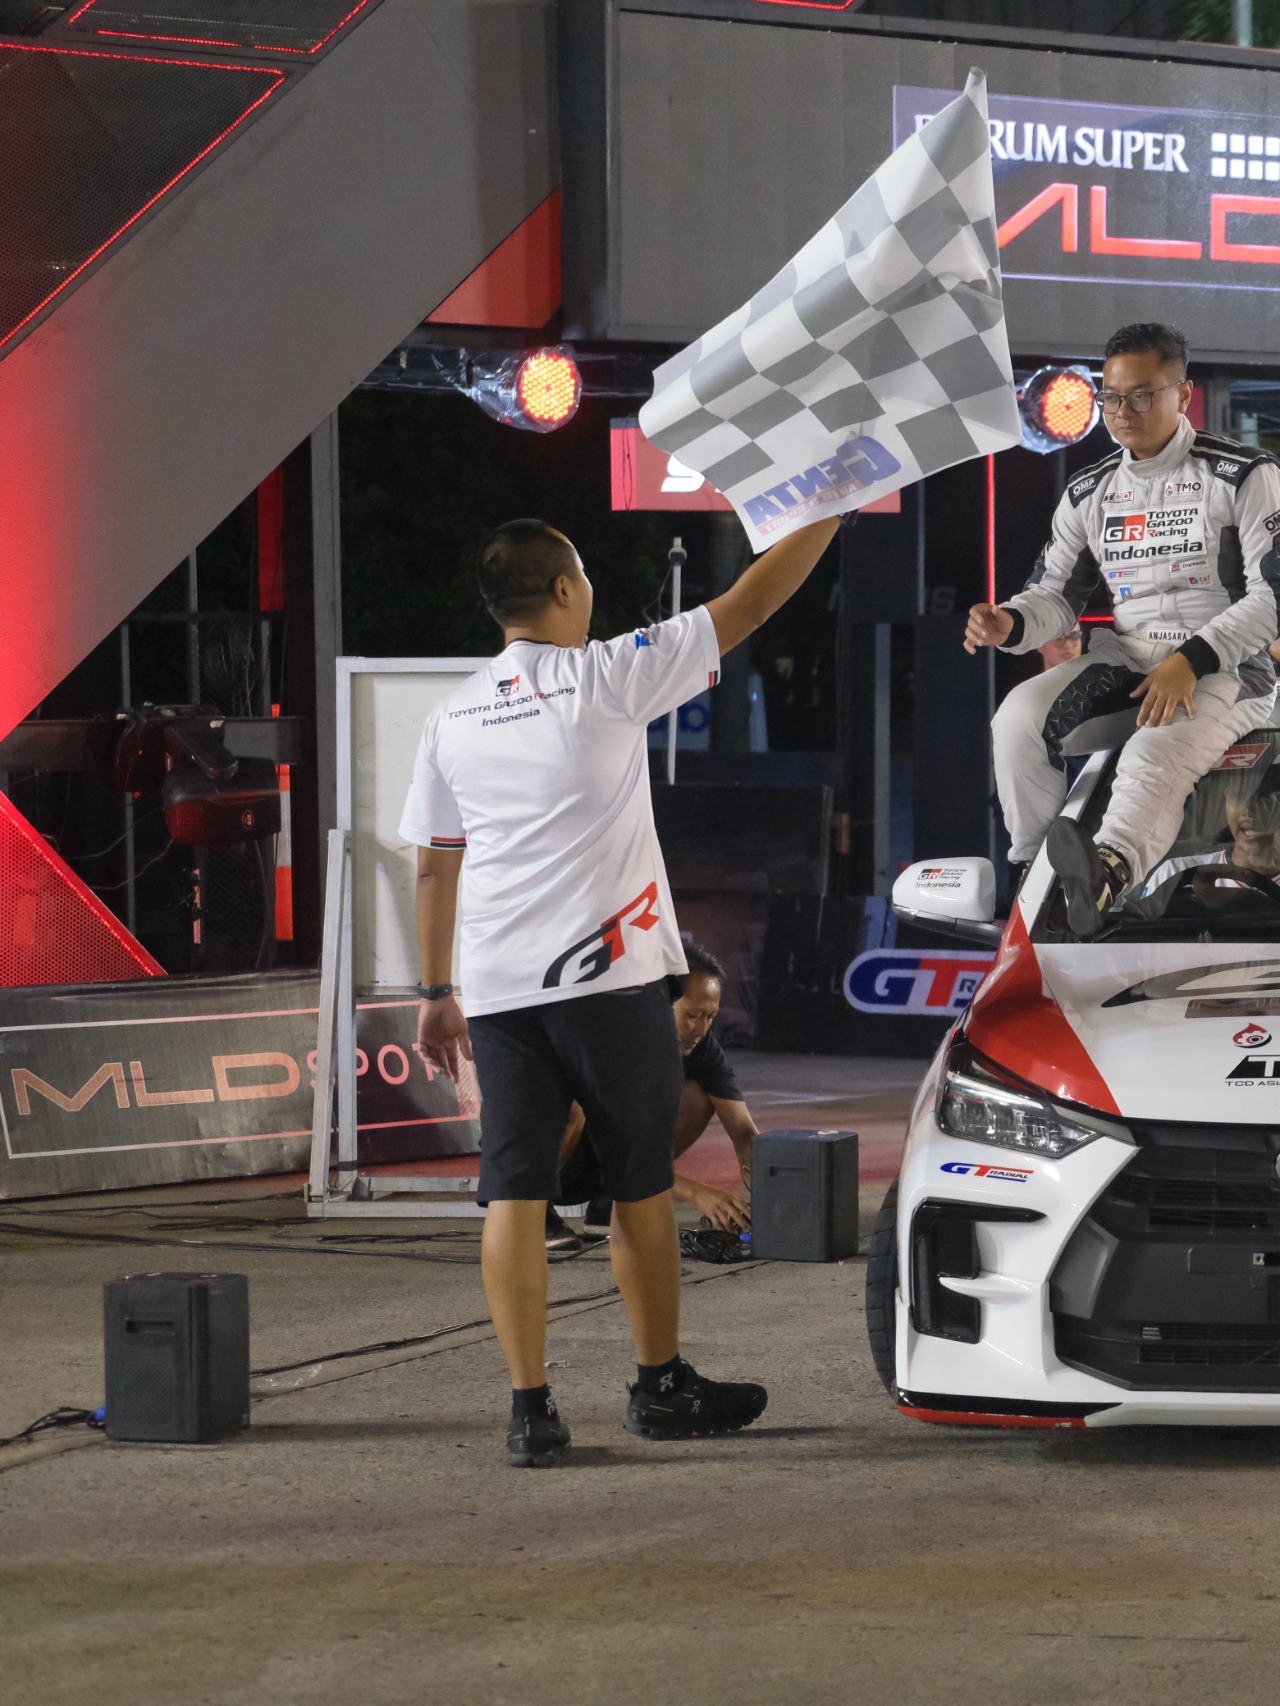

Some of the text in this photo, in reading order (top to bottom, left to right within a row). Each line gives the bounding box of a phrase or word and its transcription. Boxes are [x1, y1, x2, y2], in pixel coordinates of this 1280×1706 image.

[1074, 131, 1190, 173] SUPER
[1217, 462, 1239, 474] OMP
[1073, 479, 1095, 495] OMP
[1176, 482, 1201, 492] TMO
[1146, 508, 1198, 520] TOYOTA
[1146, 518, 1193, 528] GAZOO
[1105, 525, 1145, 542] GR
[1146, 527, 1188, 538] Racing
[1104, 539, 1203, 561] Indonesia
[1148, 630, 1187, 641] ANJASARA
[496, 683, 520, 696] GR
[448, 685, 576, 719] TOYOTA GAZOO Racing
[482, 708, 540, 727] Indonesia
[543, 881, 660, 989] GR
[849, 957, 980, 1008] GT
[11, 1051, 301, 1115] MLD
[940, 1162, 1029, 1179] GT RADIAL
